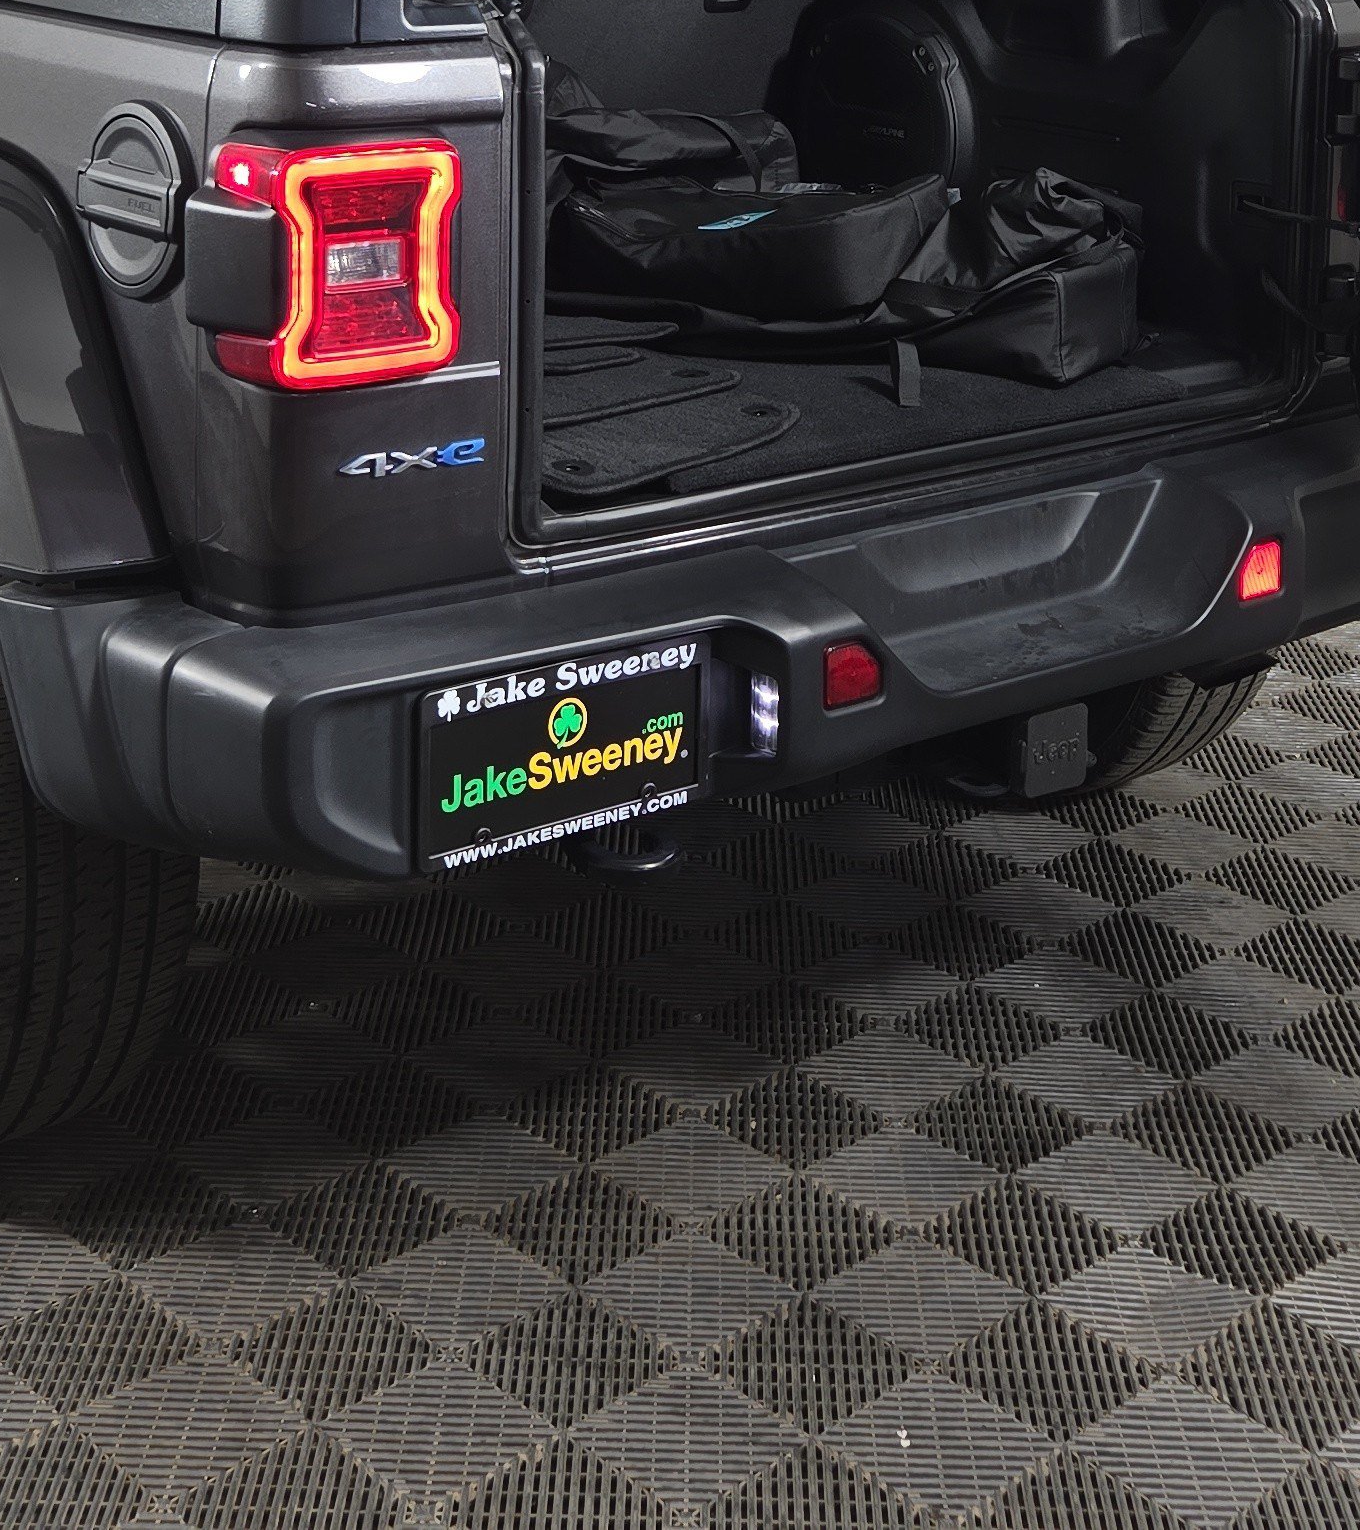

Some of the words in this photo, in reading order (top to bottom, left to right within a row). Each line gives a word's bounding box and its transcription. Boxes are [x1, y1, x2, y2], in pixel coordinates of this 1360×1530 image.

[128, 197, 155, 213] FUEL
[466, 675, 546, 713] Jake
[555, 642, 697, 691] Sweeney
[444, 790, 688, 869] WWW.JAKESWEENEY.COM
